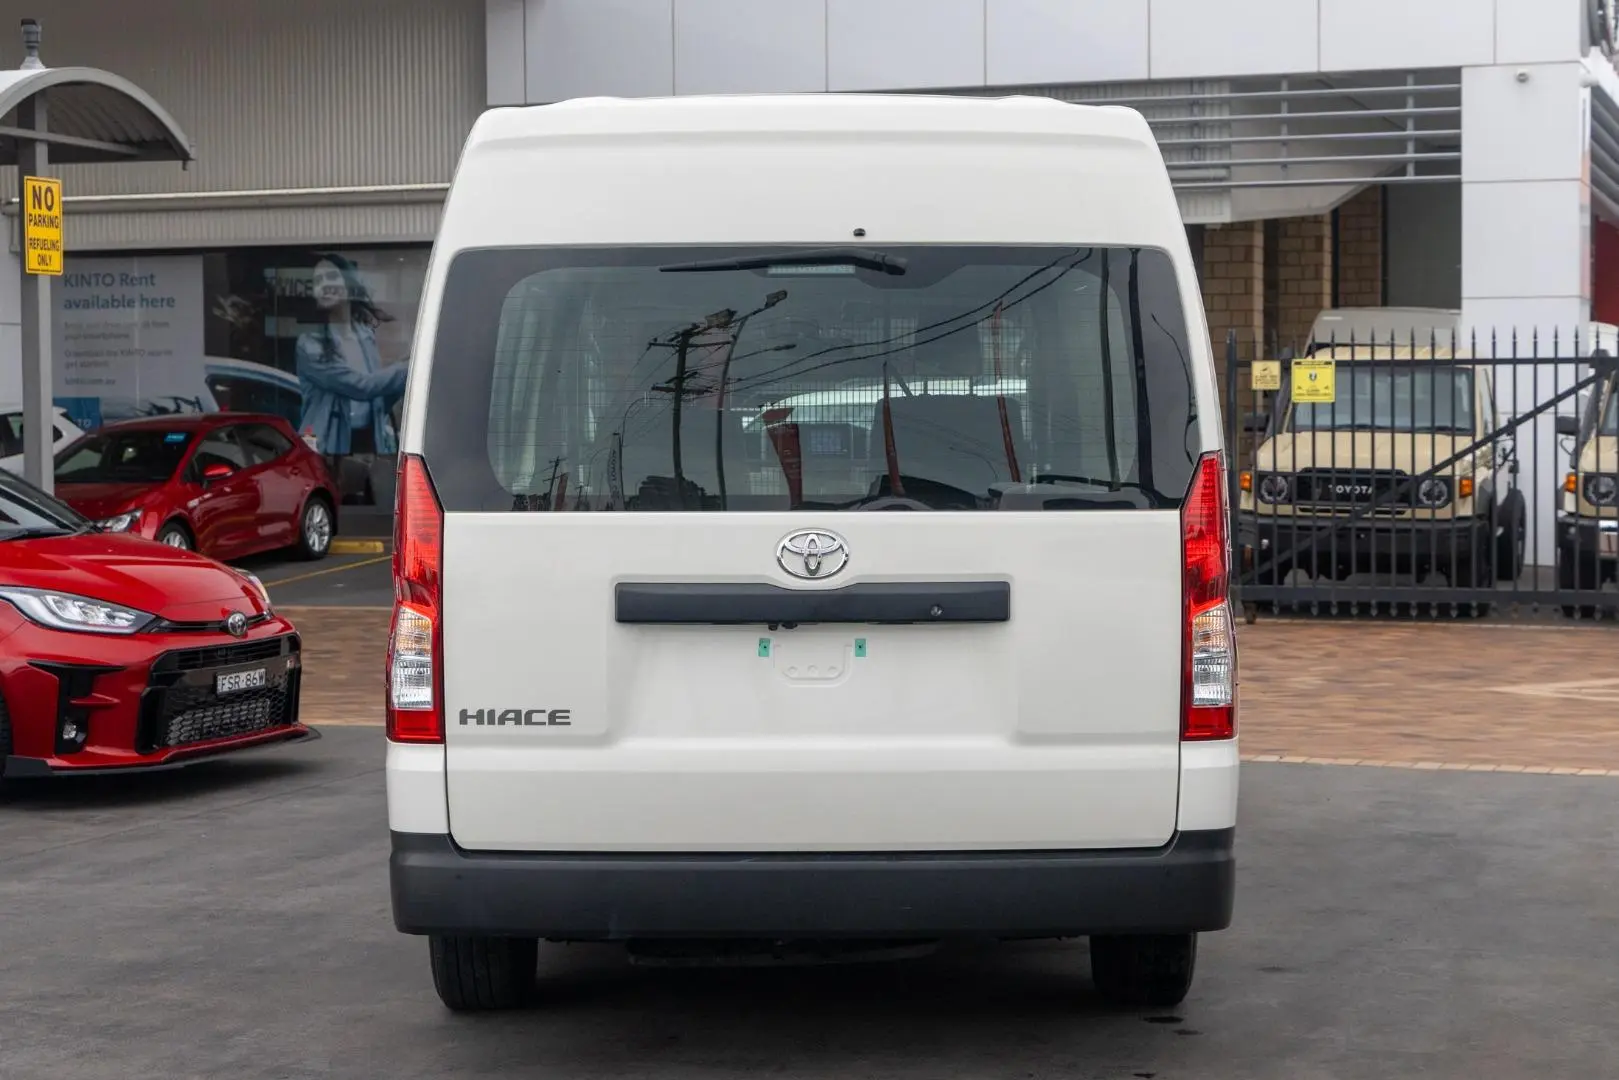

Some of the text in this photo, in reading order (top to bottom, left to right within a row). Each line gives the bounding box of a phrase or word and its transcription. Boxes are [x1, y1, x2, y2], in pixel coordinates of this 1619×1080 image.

[32, 185, 54, 212] NO
[28, 213, 60, 229] PARKING
[37, 253, 52, 267] ONLY
[64, 273, 156, 288] KINTO Rent
[64, 294, 176, 310] available here
[459, 708, 571, 726] HIACE
